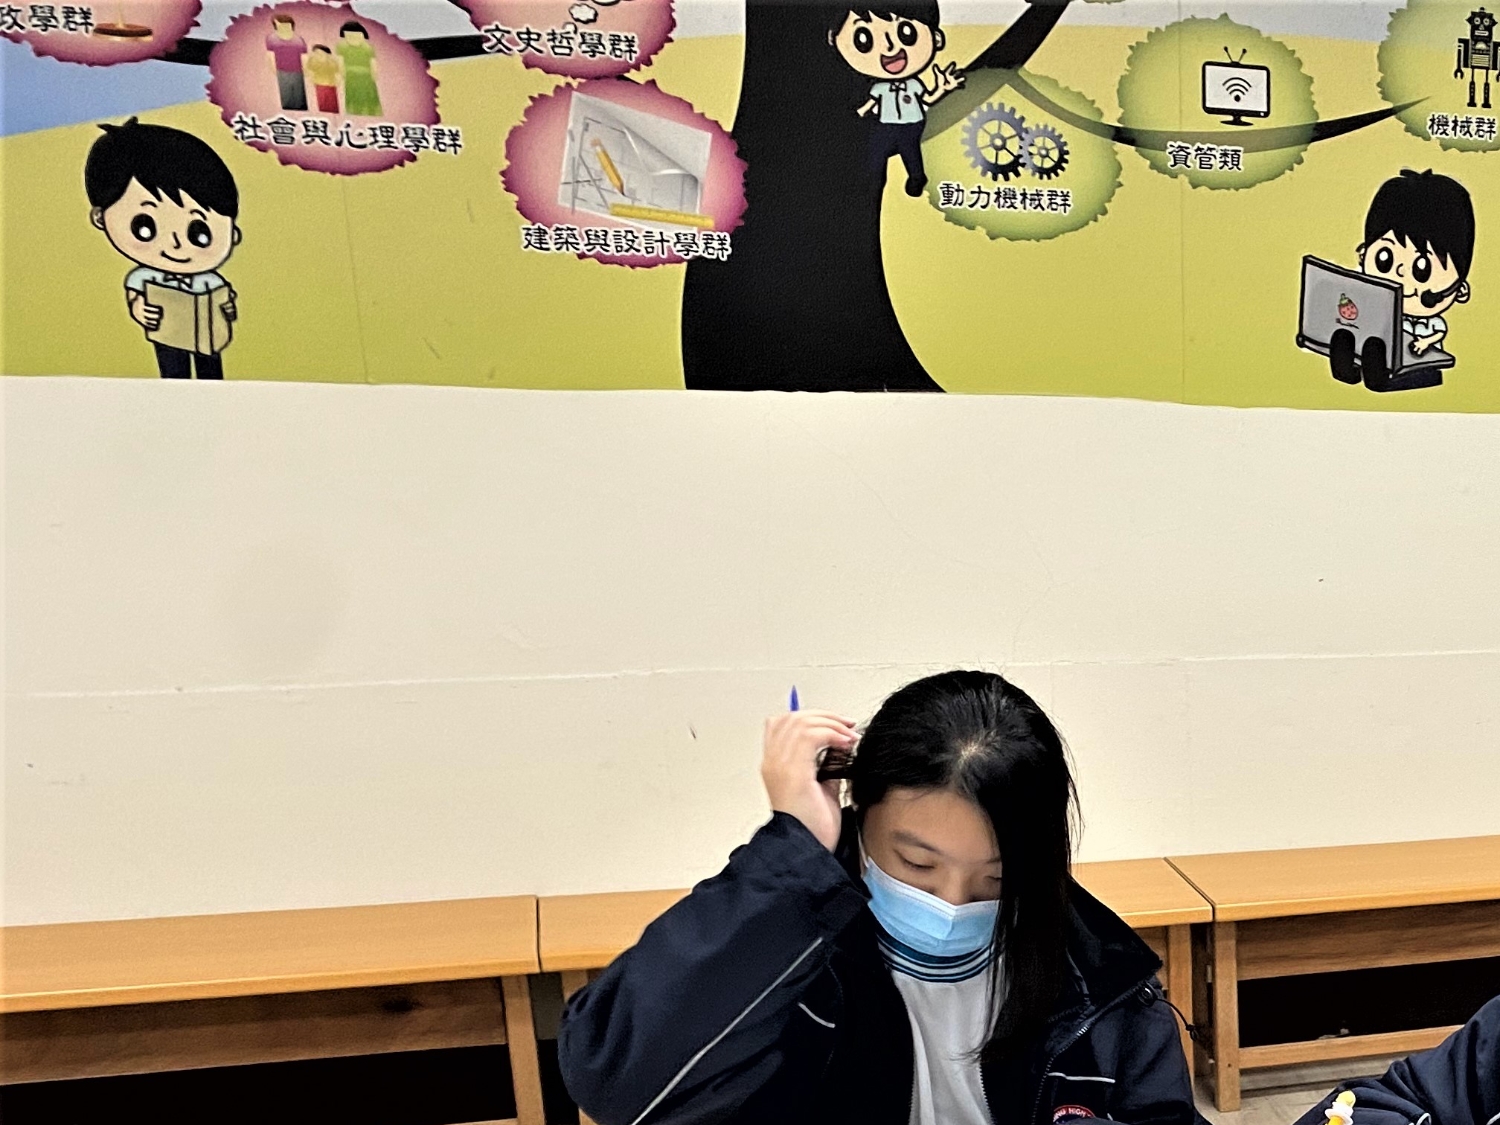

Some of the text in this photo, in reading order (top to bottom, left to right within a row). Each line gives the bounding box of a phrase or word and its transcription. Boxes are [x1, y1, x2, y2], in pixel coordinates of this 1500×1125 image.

[484, 24, 638, 61] 文史哲學群
[235, 117, 462, 154] 社會與心理學群
[1429, 116, 1496, 139] 機械群
[1169, 144, 1242, 170] 資管類
[940, 183, 1071, 213] 動力機械群
[522, 227, 730, 258] 建築與設計學群
